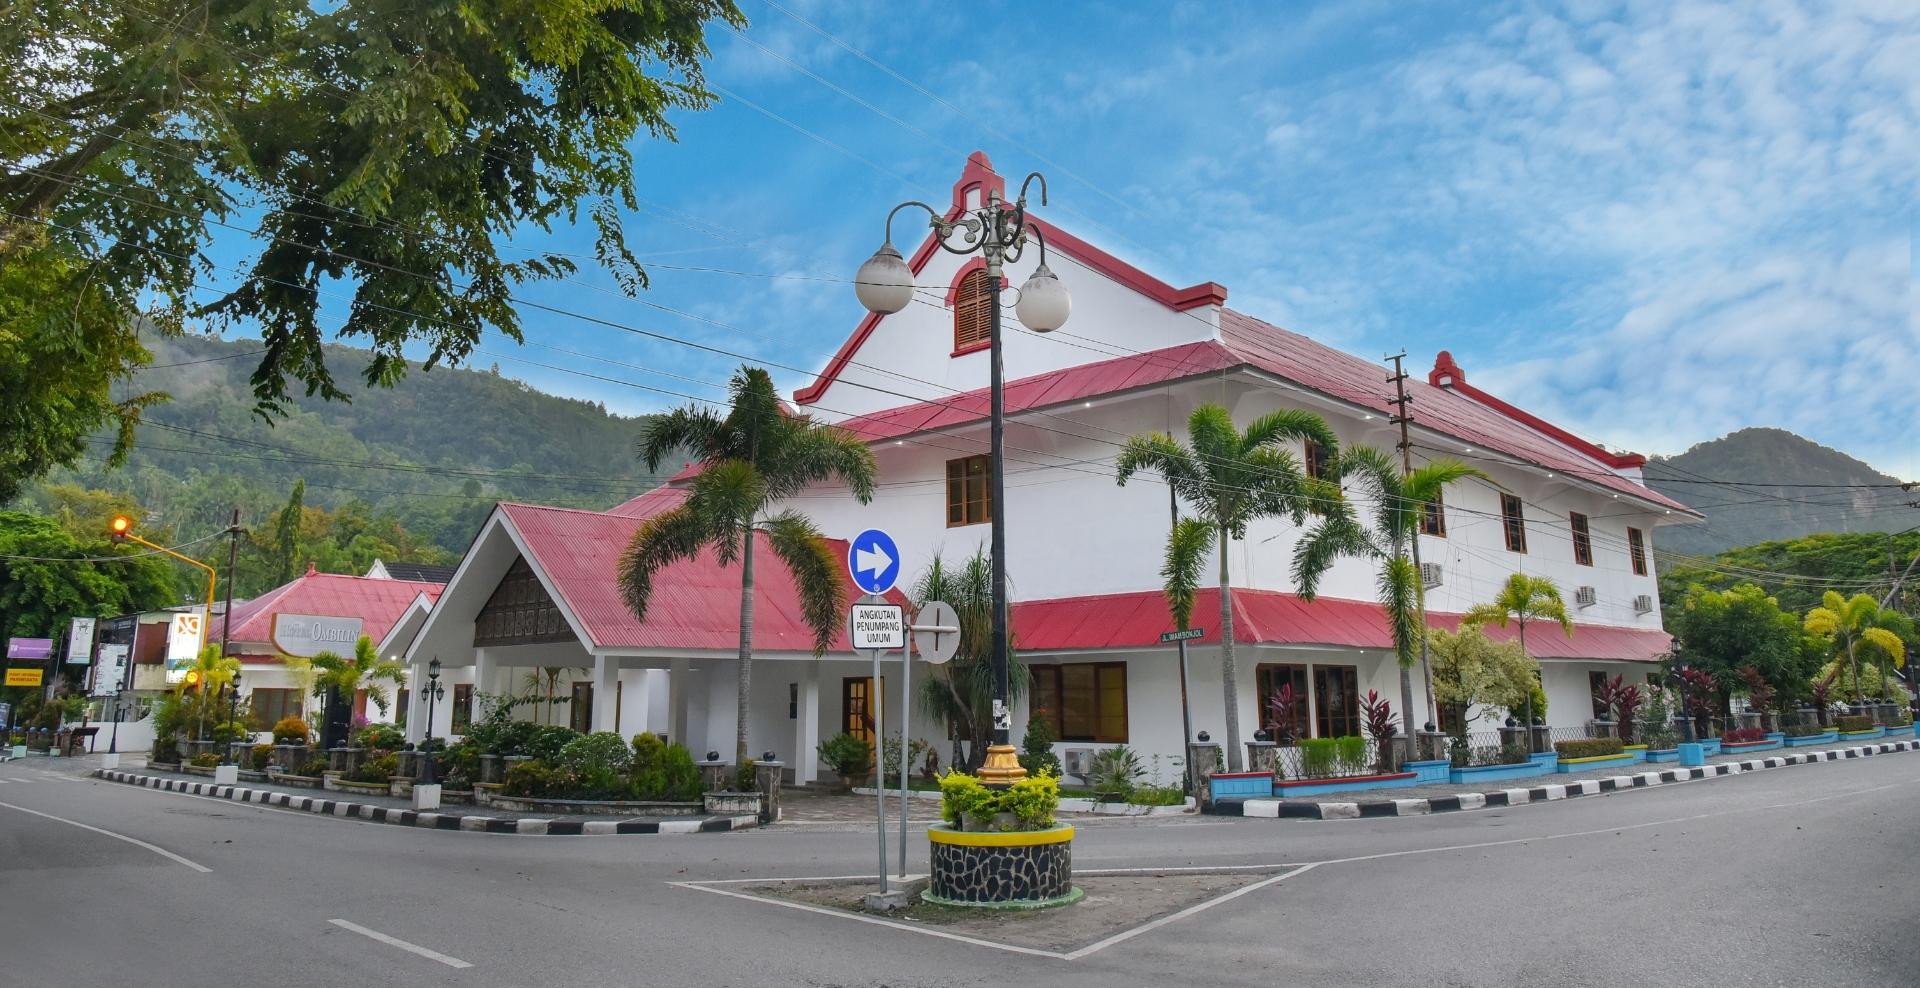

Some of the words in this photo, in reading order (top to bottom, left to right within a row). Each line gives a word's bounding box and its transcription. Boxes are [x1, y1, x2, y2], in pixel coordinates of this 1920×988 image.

[860, 609, 896, 620] ANGKUTAN
[856, 621, 900, 632] PENUMPANG
[867, 633, 891, 643] UMUM
